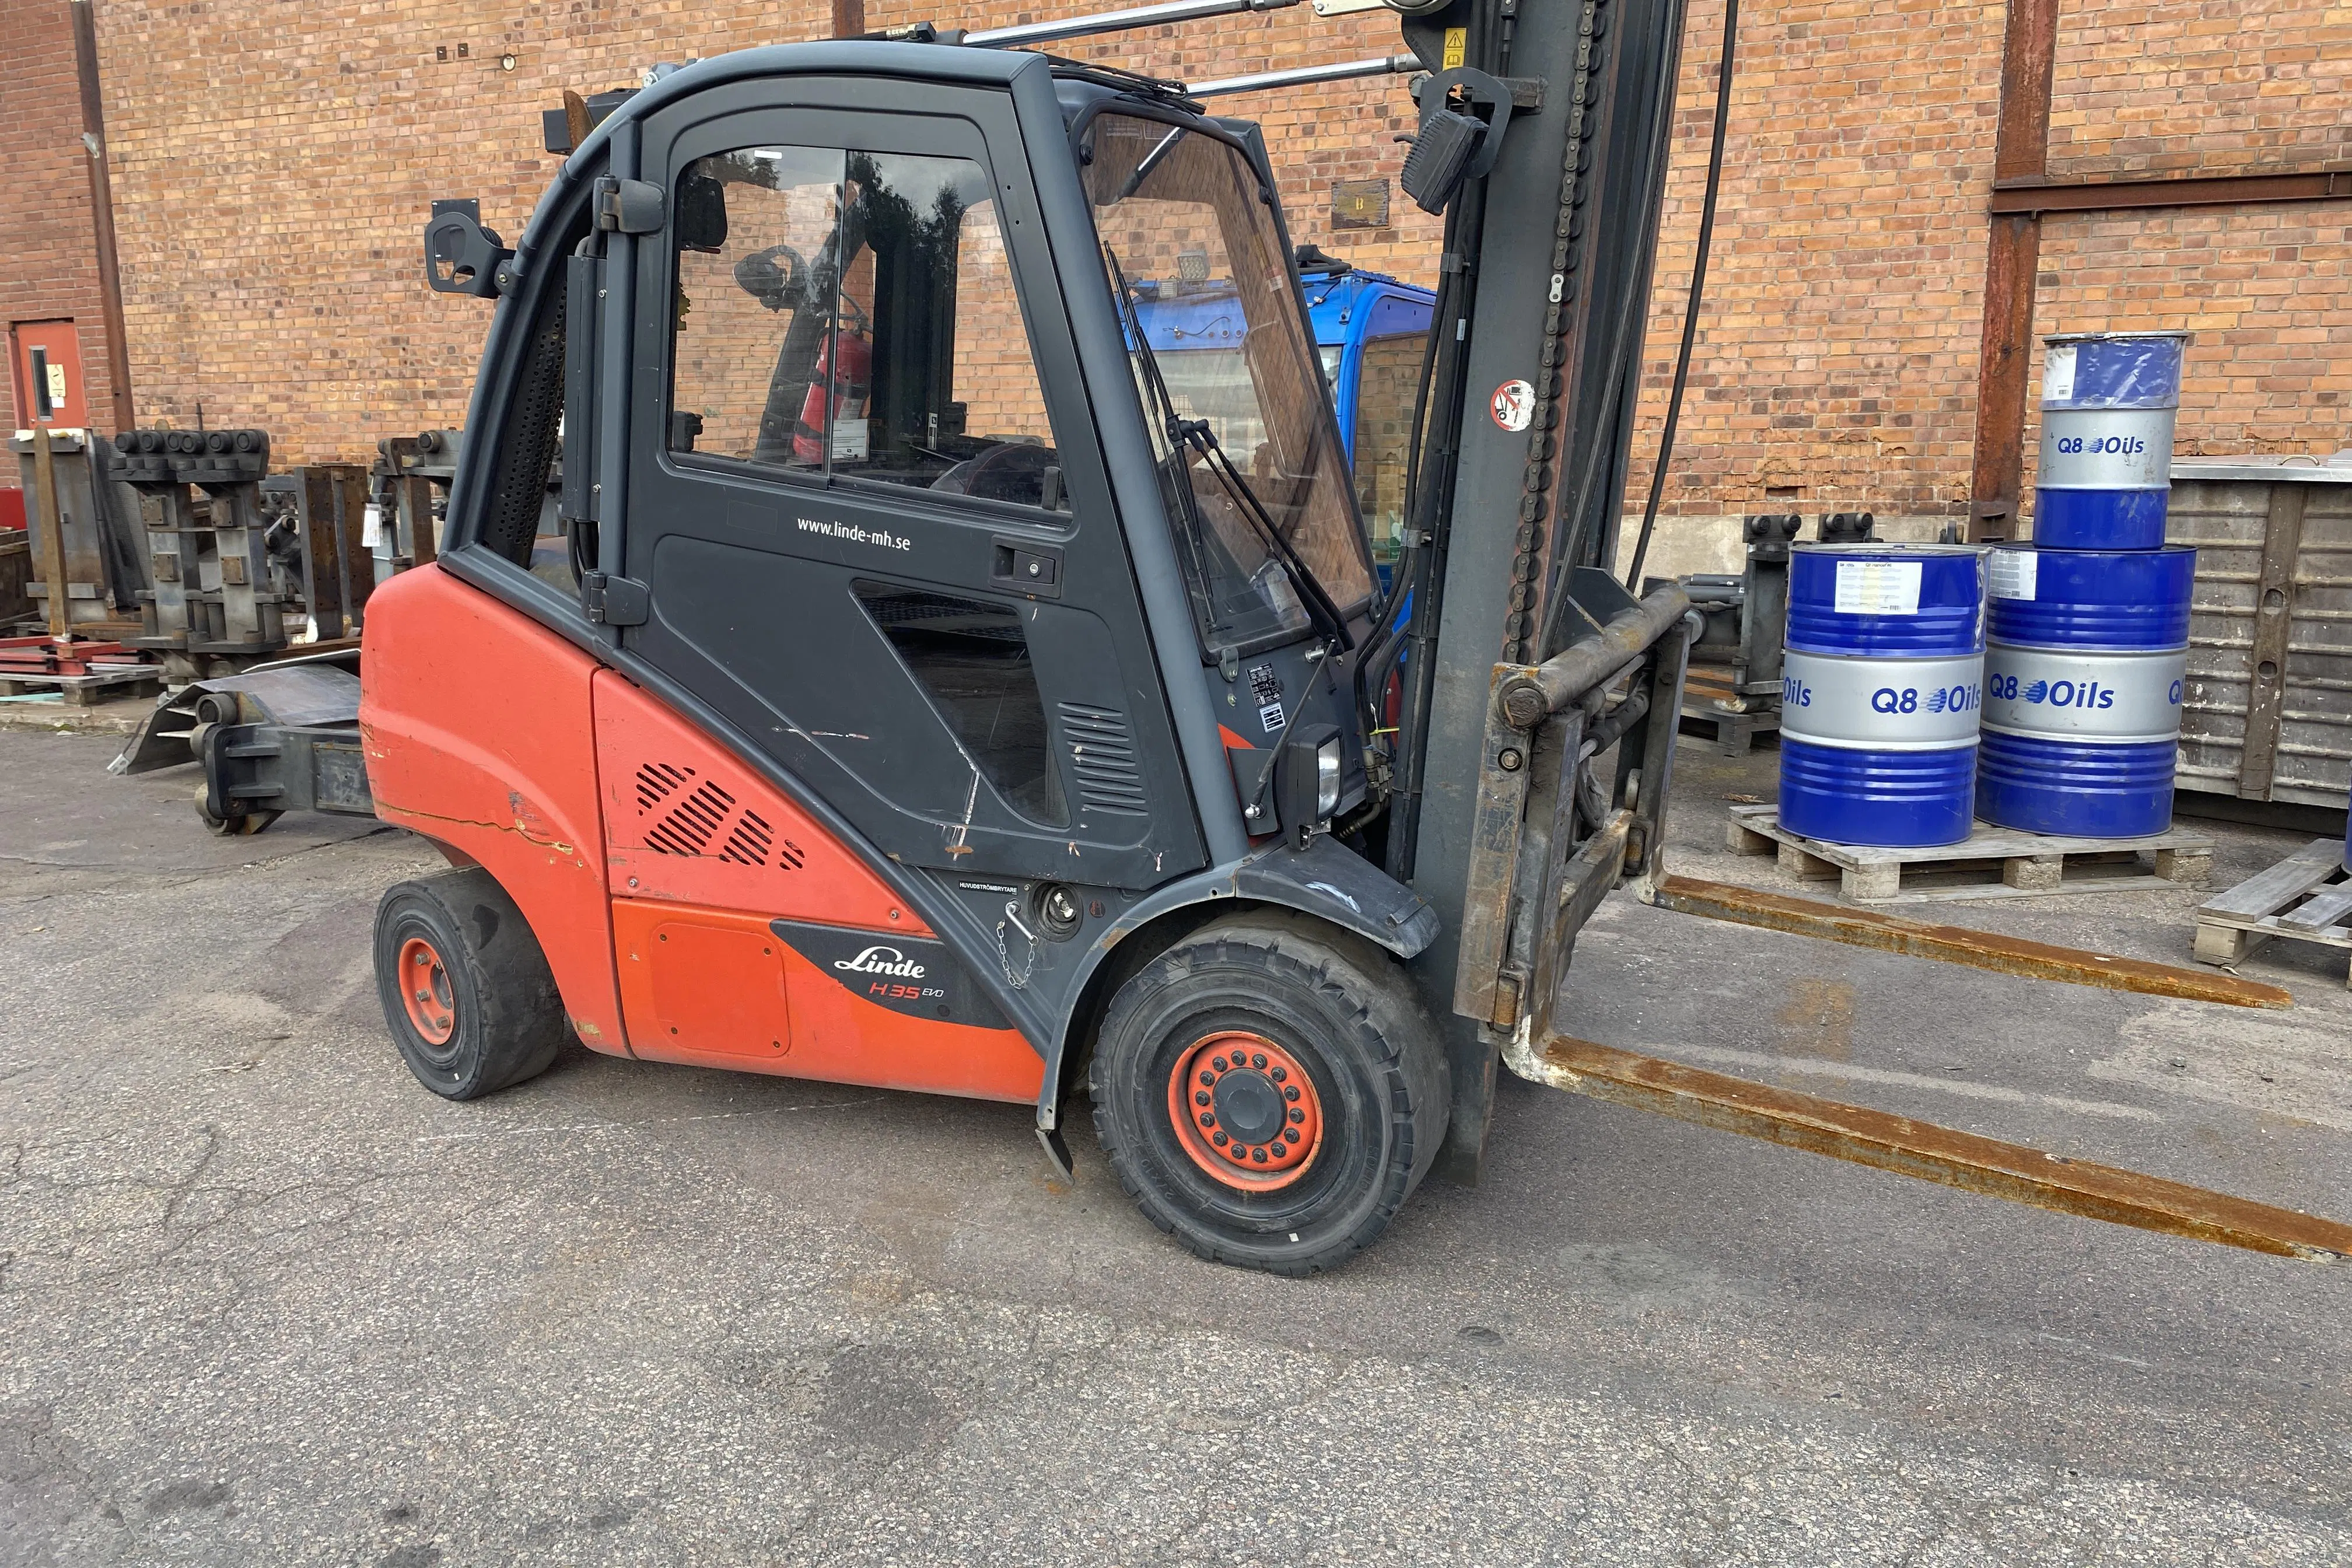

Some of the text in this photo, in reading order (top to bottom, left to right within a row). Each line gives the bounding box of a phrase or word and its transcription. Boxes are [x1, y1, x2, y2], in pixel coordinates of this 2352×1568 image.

[2058, 436, 2144, 454] Q8 Oils
[797, 517, 911, 551] www.linde-mh.se
[1784, 676, 1811, 707] Oils
[1871, 683, 1981, 715] Q8 Oils
[1990, 673, 2115, 709] Q8 Oils
[959, 882, 1018, 893] HUVUDSTRÖMBRYTARE
[834, 946, 925, 979] Linde
[888, 984, 921, 1000] 35
[922, 988, 944, 998] EVO
